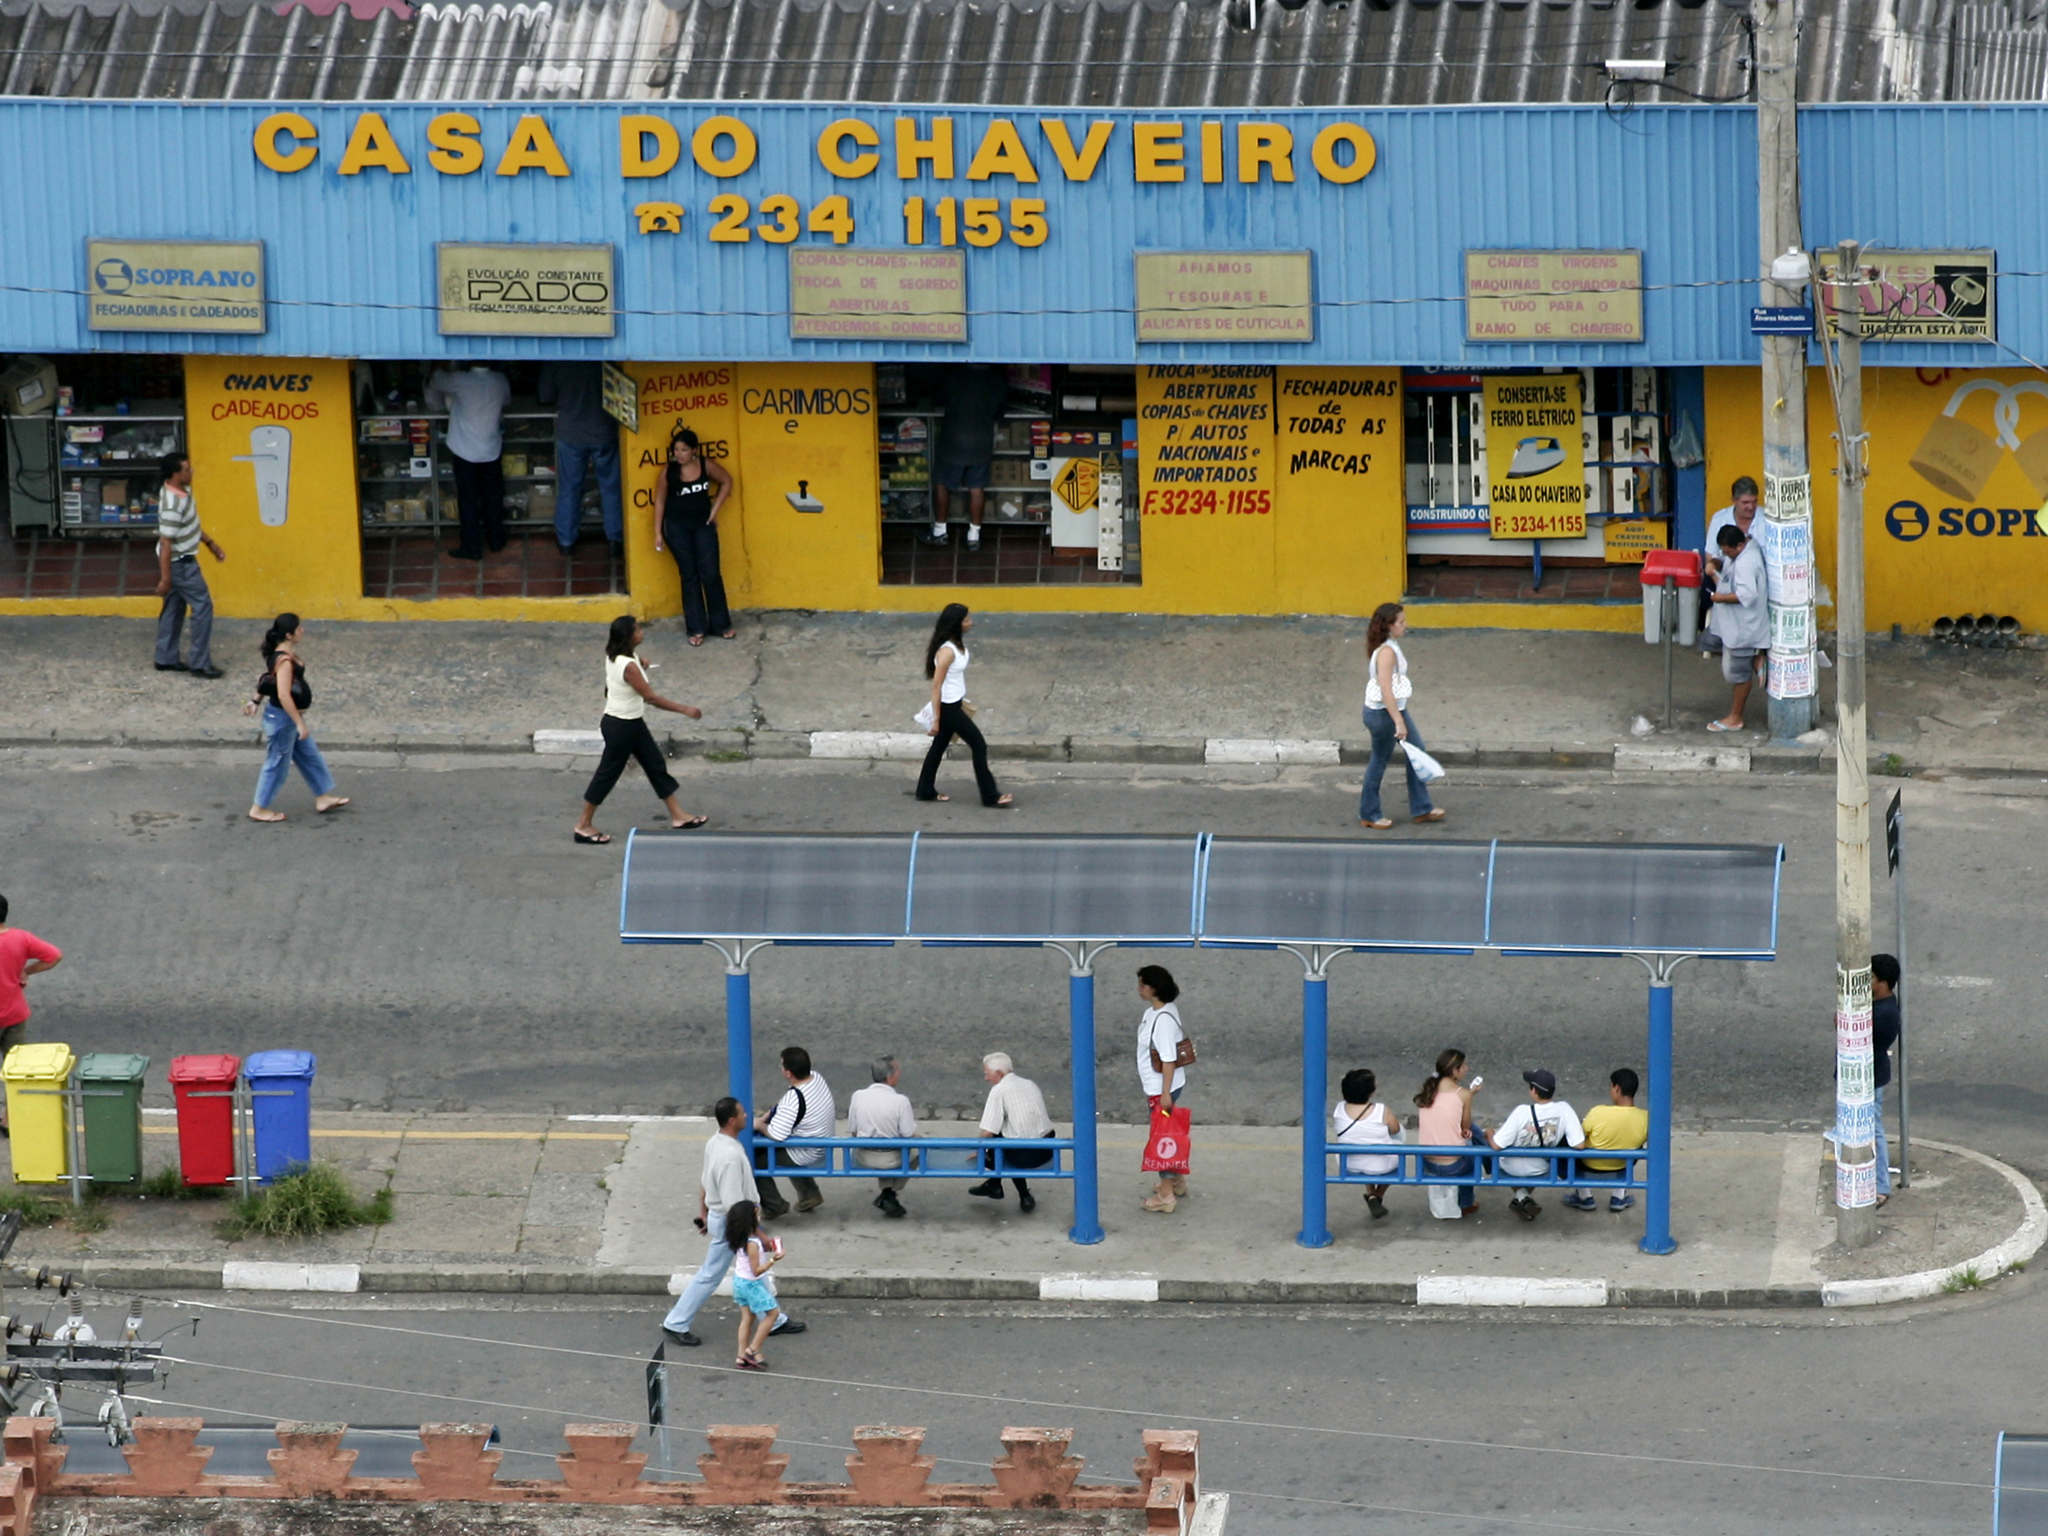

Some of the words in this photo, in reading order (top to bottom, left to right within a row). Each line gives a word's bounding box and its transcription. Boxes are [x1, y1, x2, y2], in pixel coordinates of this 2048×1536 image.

[253, 111, 571, 176] CASA
[619, 114, 758, 179] DO
[817, 117, 1377, 185] CHAVEIRO
[708, 193, 854, 244] 234
[903, 196, 1049, 247] 1155
[855, 255, 906, 268] CHAVES
[919, 256, 958, 269] HORA
[1178, 261, 1253, 274] AFIAMOS
[1487, 256, 1539, 269] CHAVES
[1561, 256, 1619, 269] VIRGENS
[135, 267, 257, 288] SOPRANO
[537, 270, 605, 281] CONSTANTE
[796, 276, 842, 289] TROCA
[860, 277, 877, 289] DE
[899, 278, 959, 291] SEGREDO
[468, 280, 609, 303] PADO
[1551, 279, 1638, 292] COPIADORAS
[828, 299, 911, 312] ABERTURAS
[1167, 290, 1253, 304] TESOURAS
[1259, 290, 1268, 304] E
[95, 303, 177, 318] FECHADURAS
[189, 306, 259, 319] CADEADOS
[1501, 301, 1537, 312] TUDO
[1549, 301, 1584, 312] PARA
[1598, 301, 1608, 312] O
[795, 318, 881, 333] ATENDEMOS
[891, 320, 962, 335] DOMICILIO
[1142, 317, 1212, 330] ALICATES
[1215, 318, 1233, 330] DE
[1475, 323, 1517, 335] RAMO
[1535, 323, 1552, 335] DE
[1570, 323, 1634, 335] CHAVEIRO
[1147, 365, 1195, 379] TROCA
[1210, 365, 1273, 379] SEGREDO
[223, 373, 313, 393] CHAVES
[642, 367, 731, 395] AFIAMOS
[1282, 379, 1398, 397] FECHADURAS
[1163, 383, 1258, 400] ABERTURAS
[1497, 386, 1567, 404] CONSERTA-SE
[210, 399, 320, 421] CADEADOS
[640, 392, 729, 417] TESOURAS
[743, 388, 870, 415] CARIMBOS
[1317, 399, 1342, 416] de
[1141, 404, 1191, 420] COPIAS
[1206, 404, 1268, 420] CHAVES
[1490, 409, 1524, 427] FERRO
[1526, 405, 1576, 427] ELÉTRICO
[783, 418, 799, 434] e
[1190, 424, 1248, 441] AUTOS
[1288, 416, 1347, 435] TODAS
[1360, 417, 1387, 435] AS
[638, 439, 730, 469] ALITES
[1158, 445, 1248, 461] NACIONAIS
[1289, 449, 1372, 475] MARCAS
[1152, 466, 1258, 483] IMPORTADOS
[1492, 486, 1517, 502] CASA
[1519, 486, 1532, 502] DO
[1534, 484, 1582, 503] CHAVEIRO
[1410, 508, 1477, 521] CONSTRUINDO
[1494, 516, 1507, 533] F:
[1511, 515, 1583, 533] 3234-1155
[1144, 1157, 1189, 1170] RENNER
